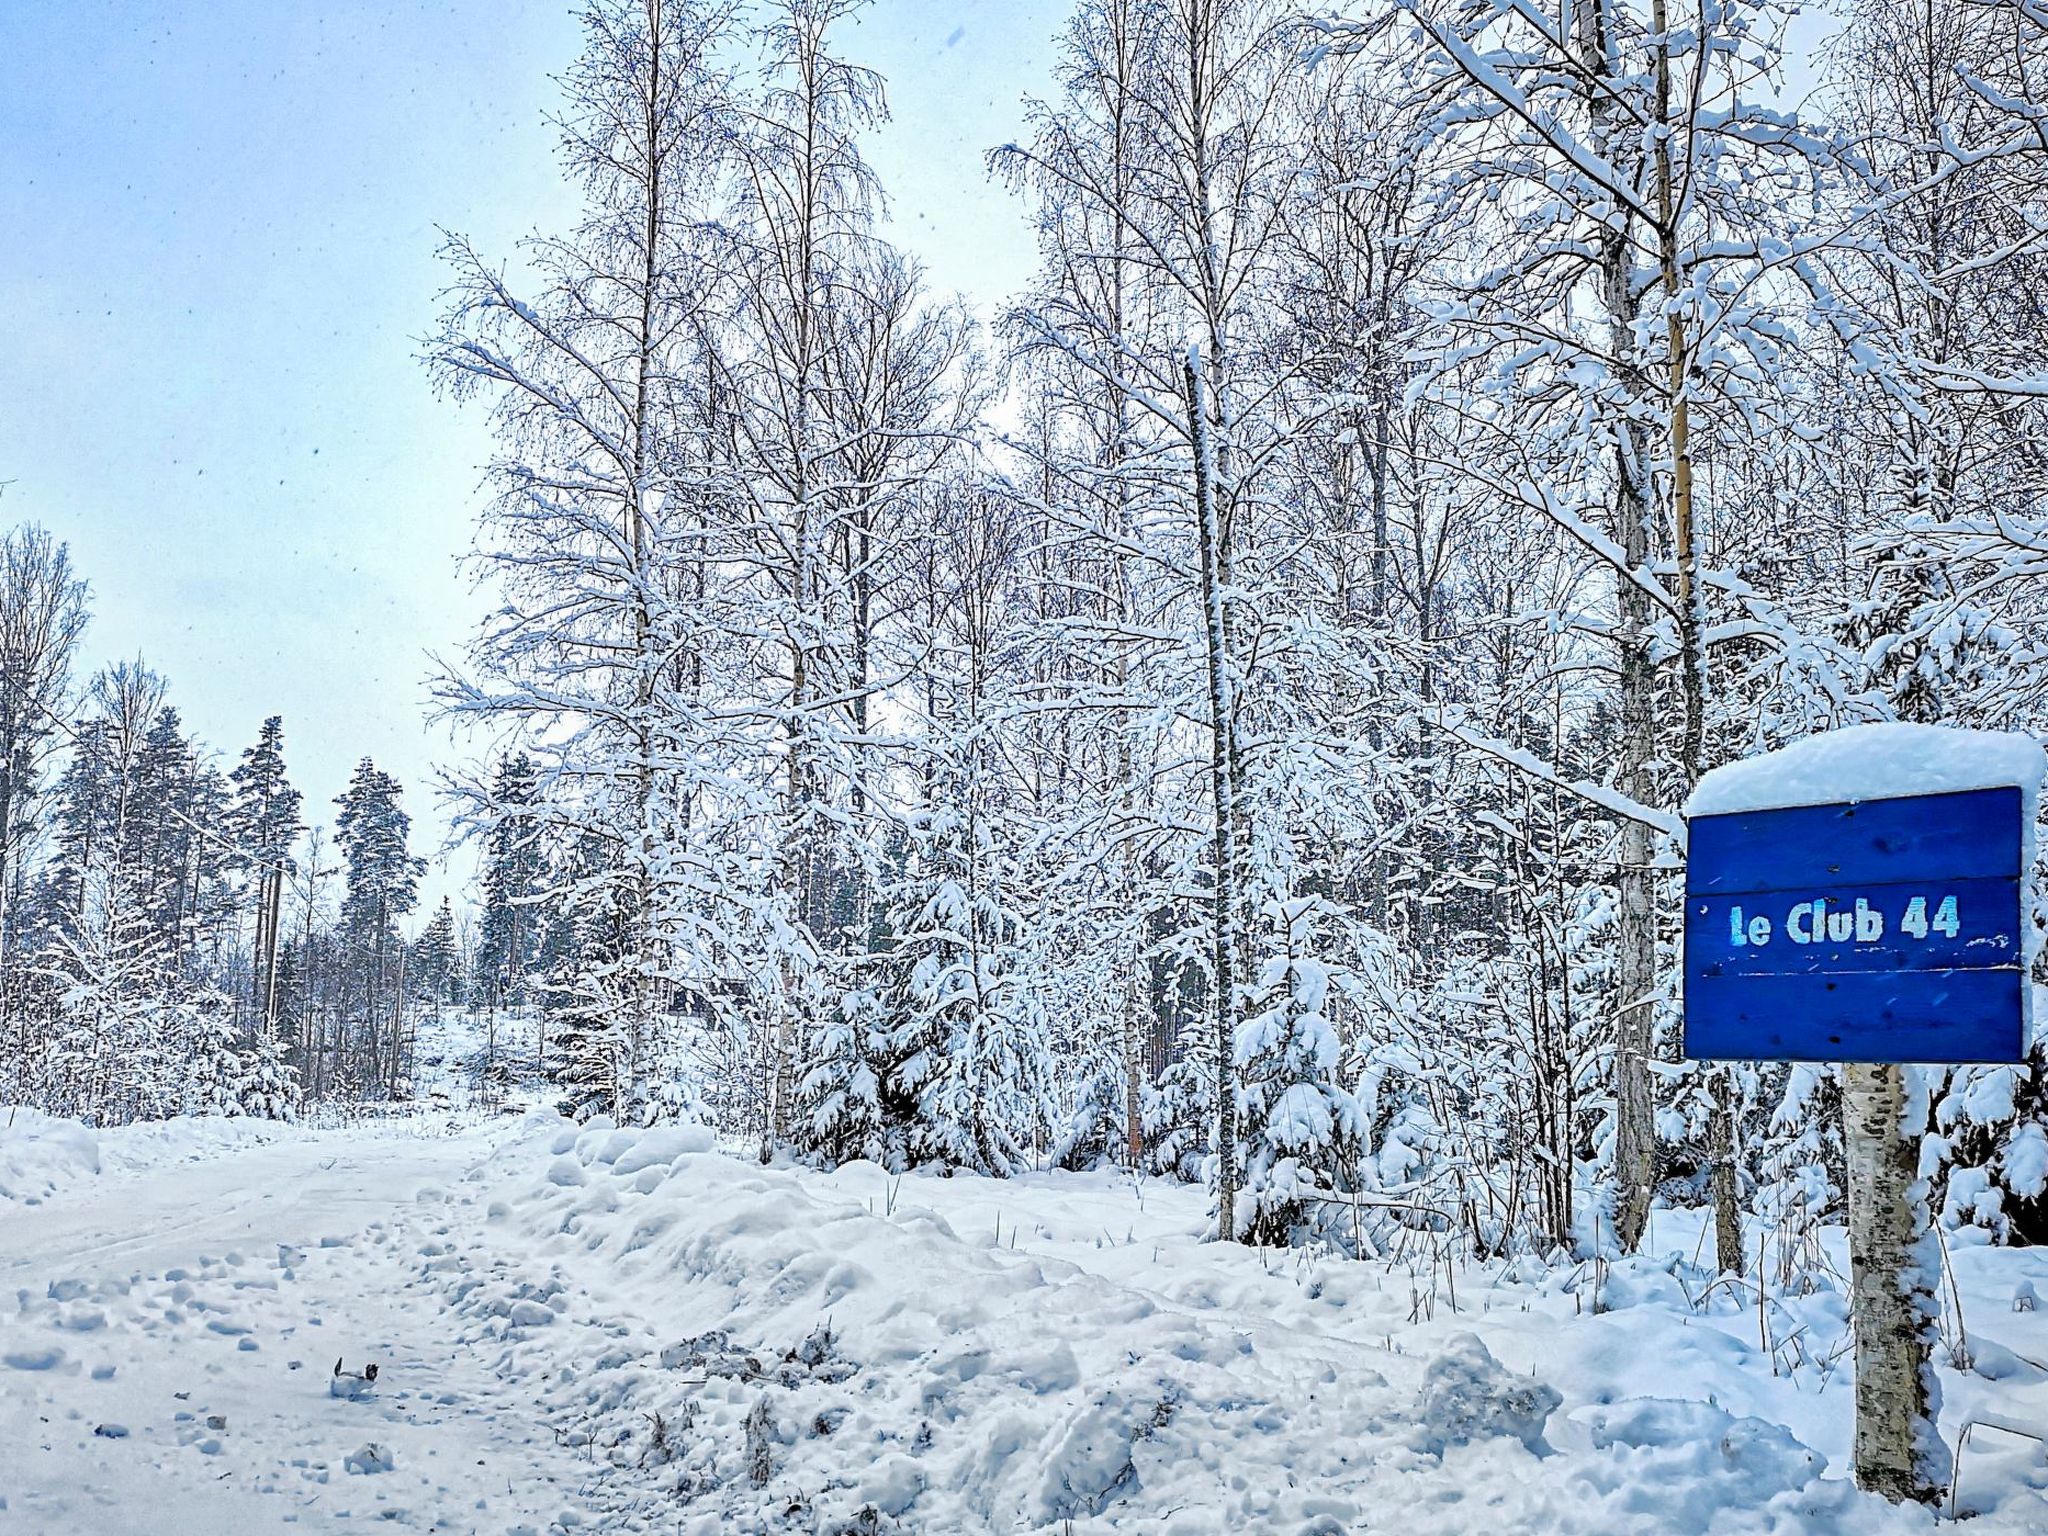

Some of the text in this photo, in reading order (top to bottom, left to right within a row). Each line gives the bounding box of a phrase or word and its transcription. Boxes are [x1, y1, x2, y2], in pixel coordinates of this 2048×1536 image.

[1730, 896, 1960, 946] Le Club 44
